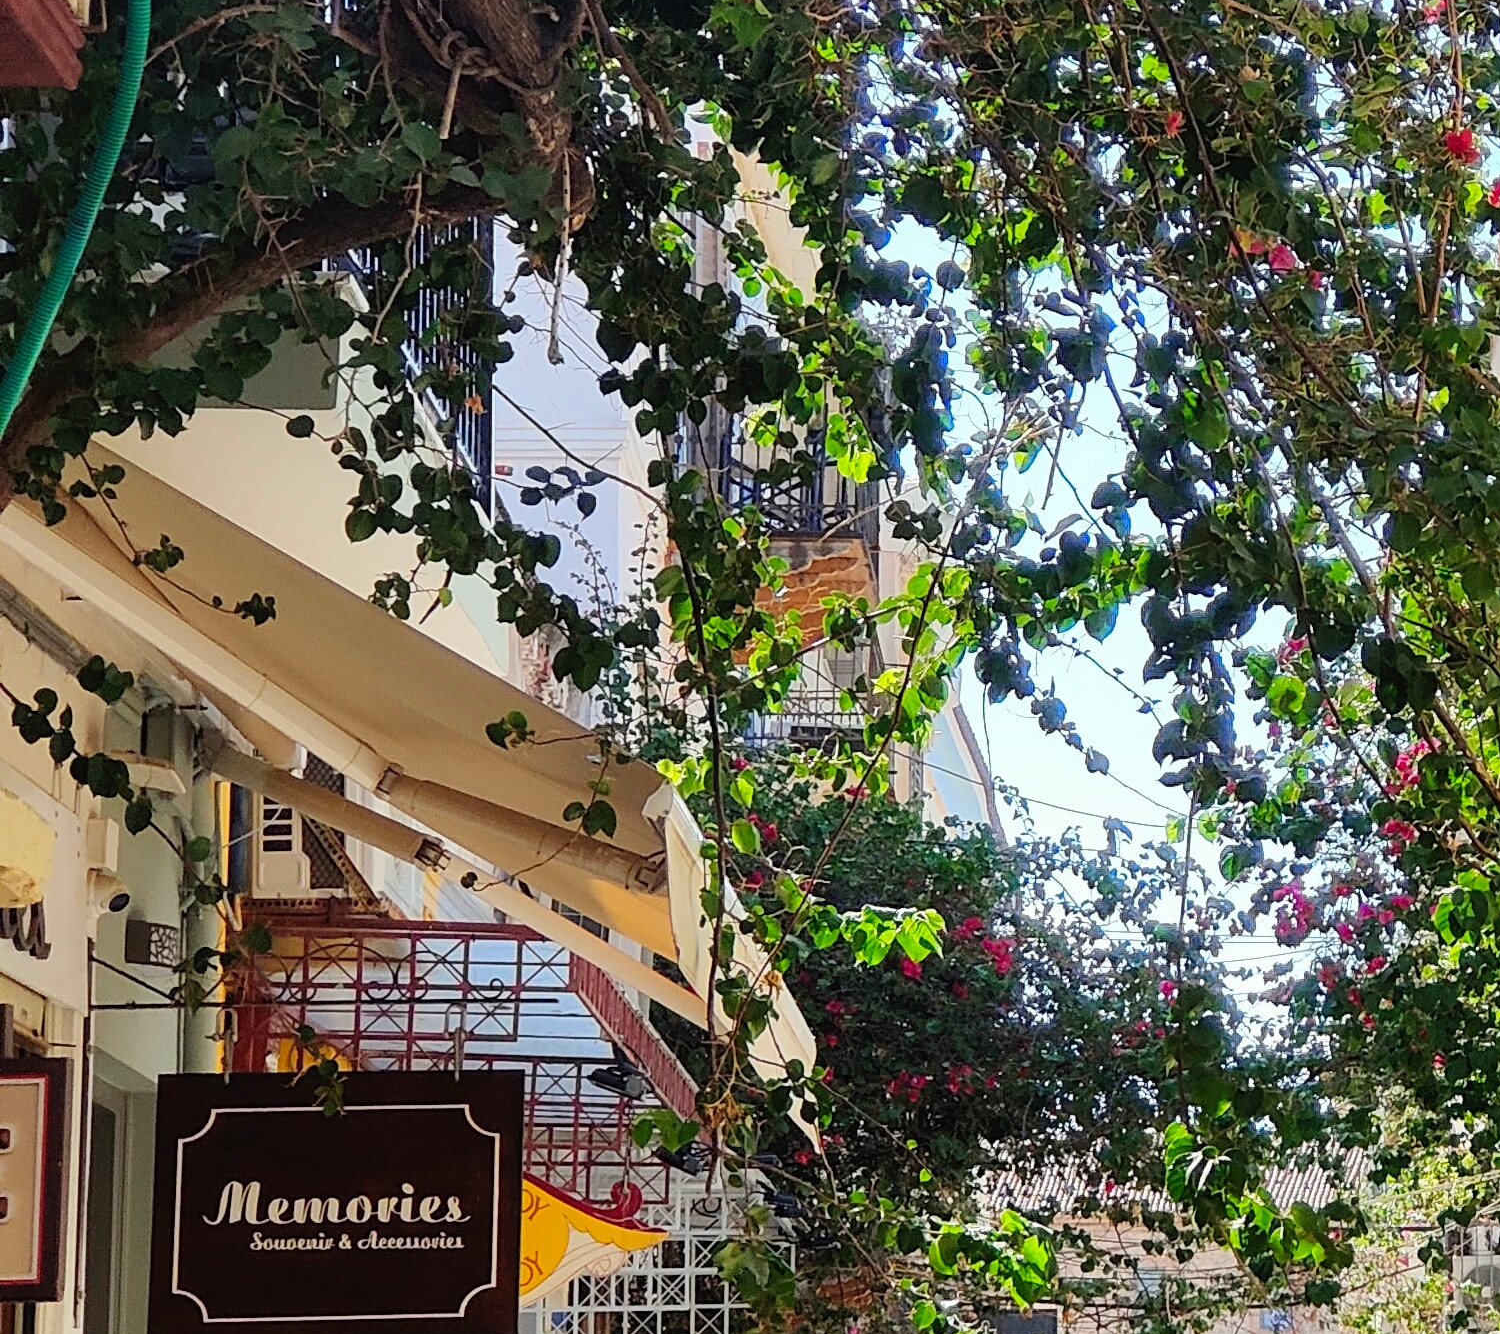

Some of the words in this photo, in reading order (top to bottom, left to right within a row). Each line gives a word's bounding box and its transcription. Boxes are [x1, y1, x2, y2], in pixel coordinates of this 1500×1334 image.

[202, 1180, 471, 1225] Memories
[250, 1231, 335, 1250] Souvenir
[338, 1233, 352, 1249] &
[357, 1230, 464, 1250] Accessories
